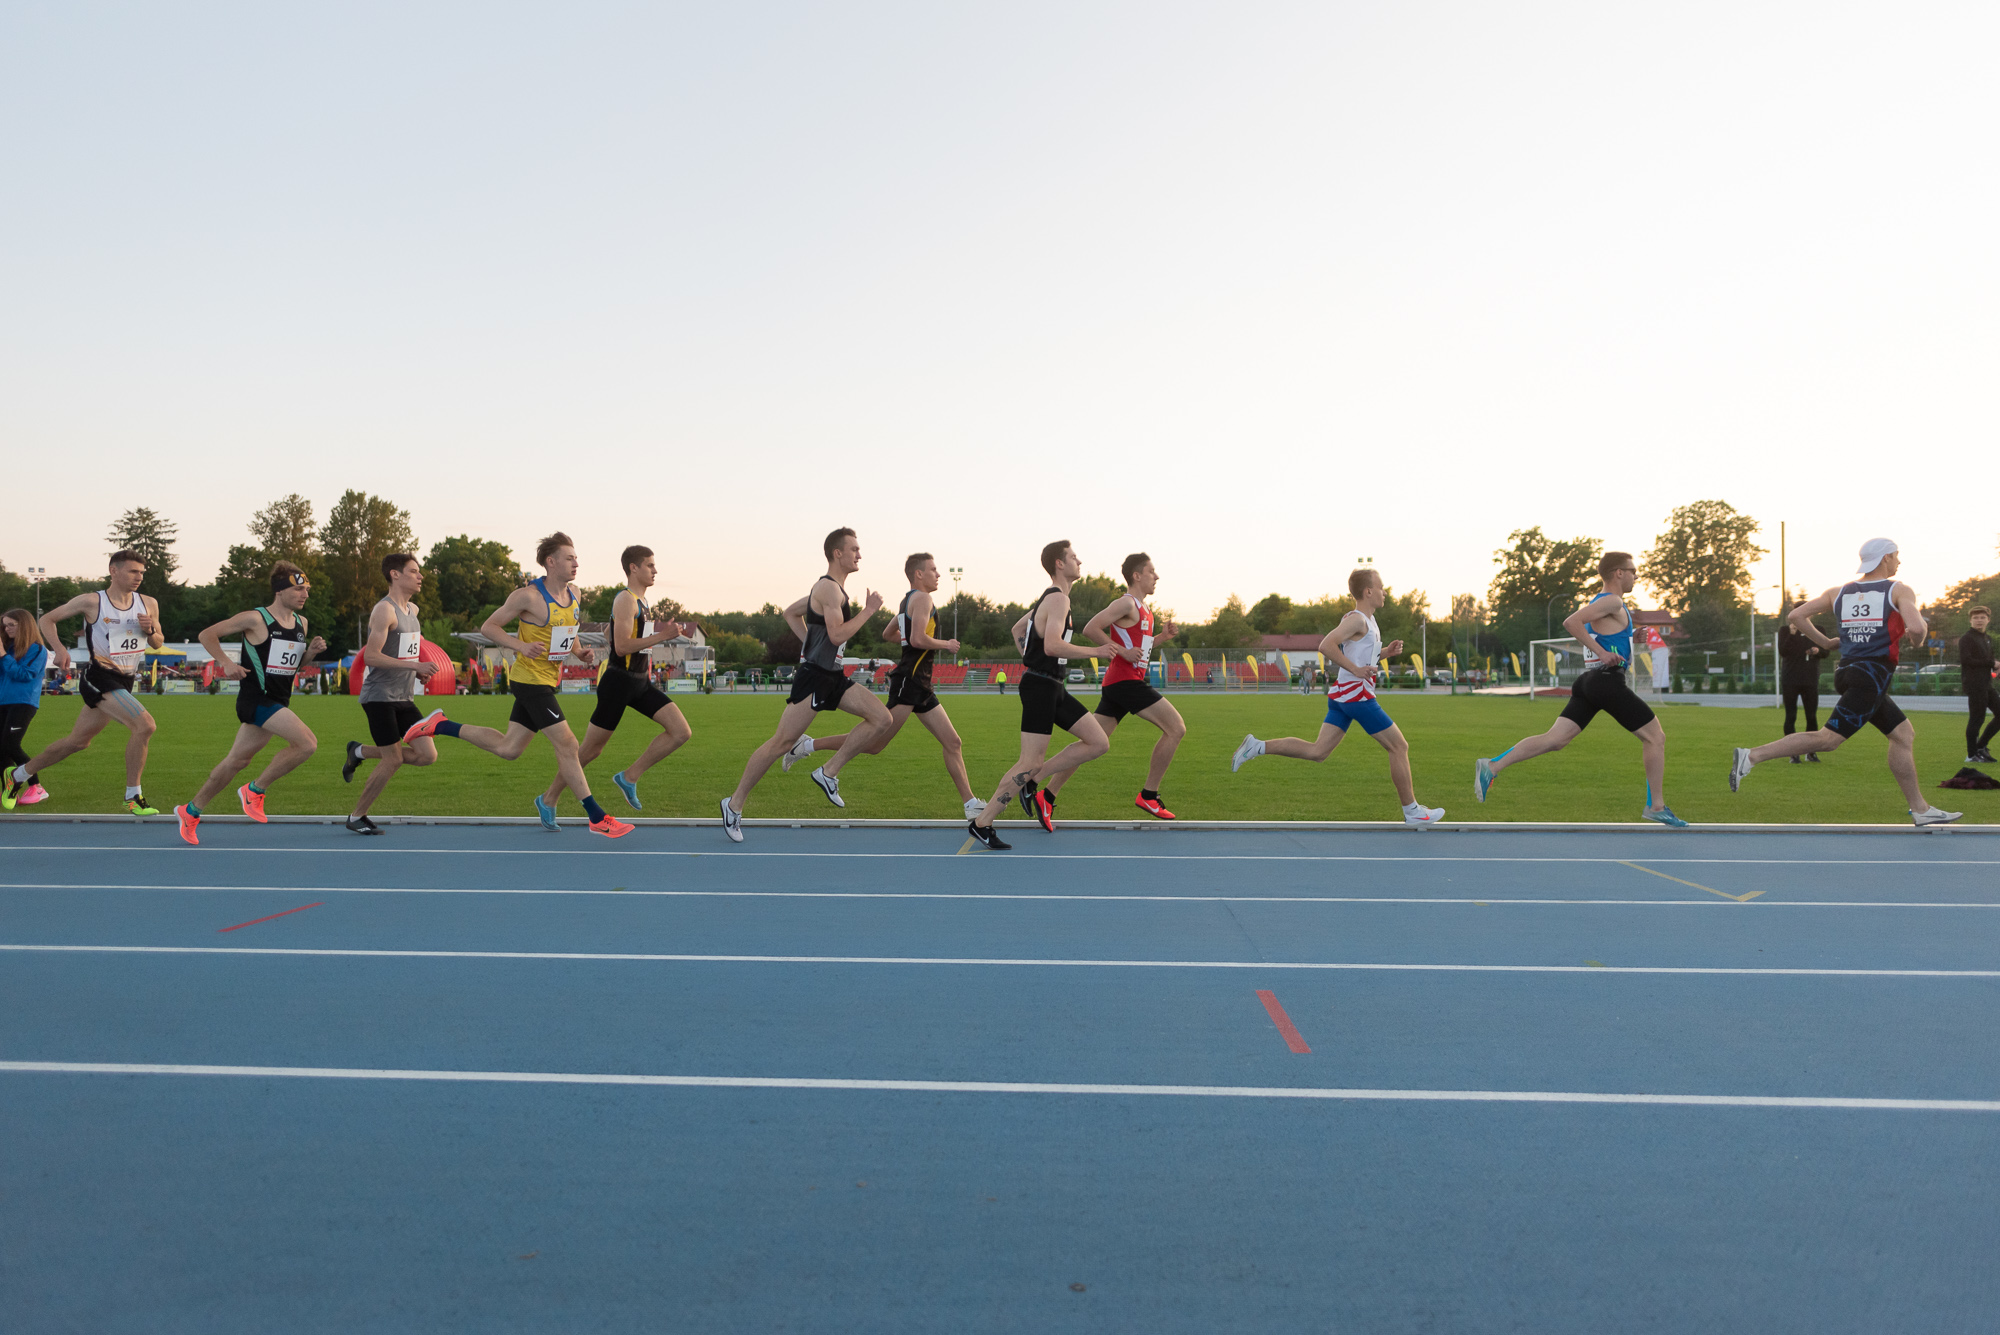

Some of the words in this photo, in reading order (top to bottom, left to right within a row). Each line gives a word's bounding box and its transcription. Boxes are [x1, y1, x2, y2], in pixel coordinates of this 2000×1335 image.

[1851, 604, 1870, 617] 33
[121, 638, 138, 650] 48
[407, 643, 418, 655] 45
[560, 637, 575, 651] 47
[280, 652, 297, 666] 50
